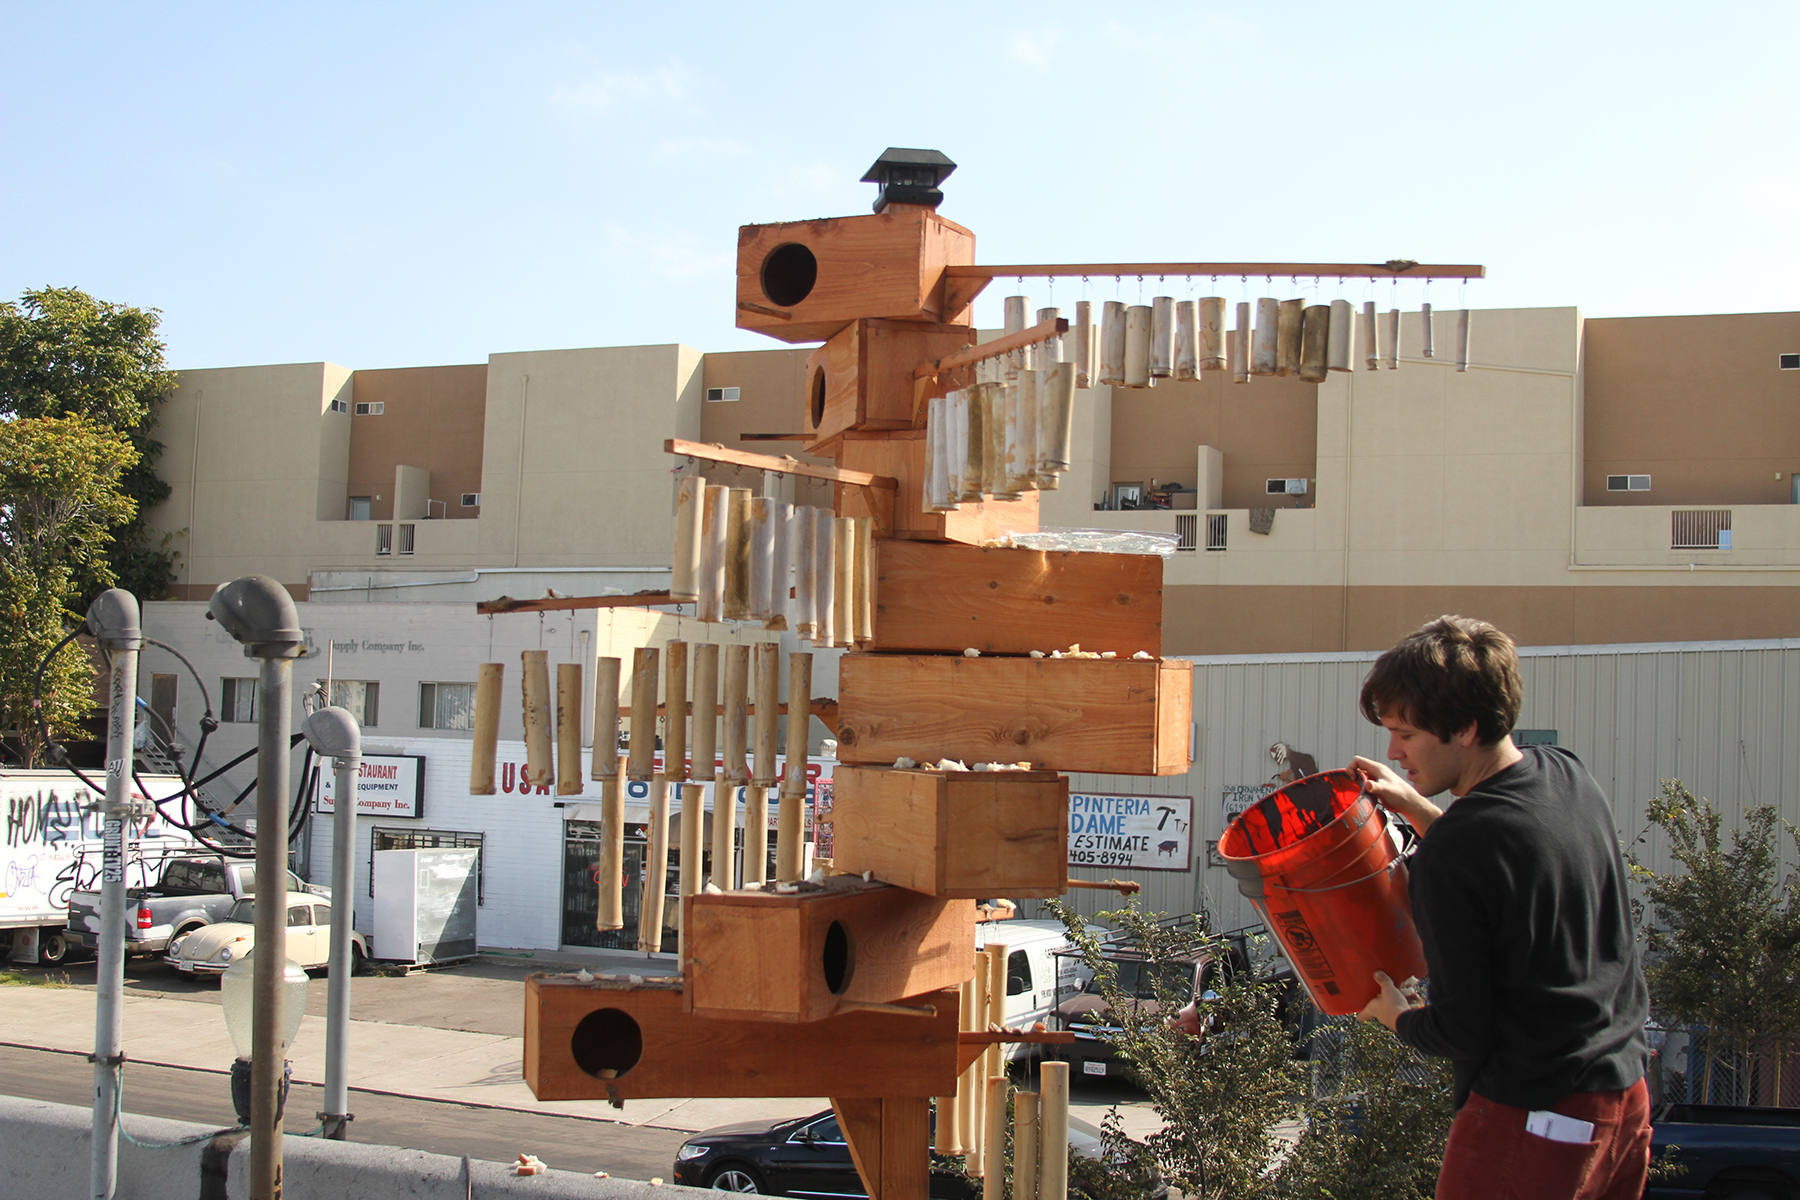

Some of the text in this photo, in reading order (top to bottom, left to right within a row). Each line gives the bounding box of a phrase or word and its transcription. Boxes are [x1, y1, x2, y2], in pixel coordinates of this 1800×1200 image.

[361, 640, 405, 653] Company
[407, 640, 425, 651] Inc.
[358, 763, 398, 779] STAURANT
[357, 783, 399, 791] EQUIPMENT
[357, 797, 410, 810] ompany Inc.
[1067, 813, 1127, 835] DAME
[1074, 835, 1150, 851] ESTIMATE
[1069, 849, 1133, 866] 405-8994
